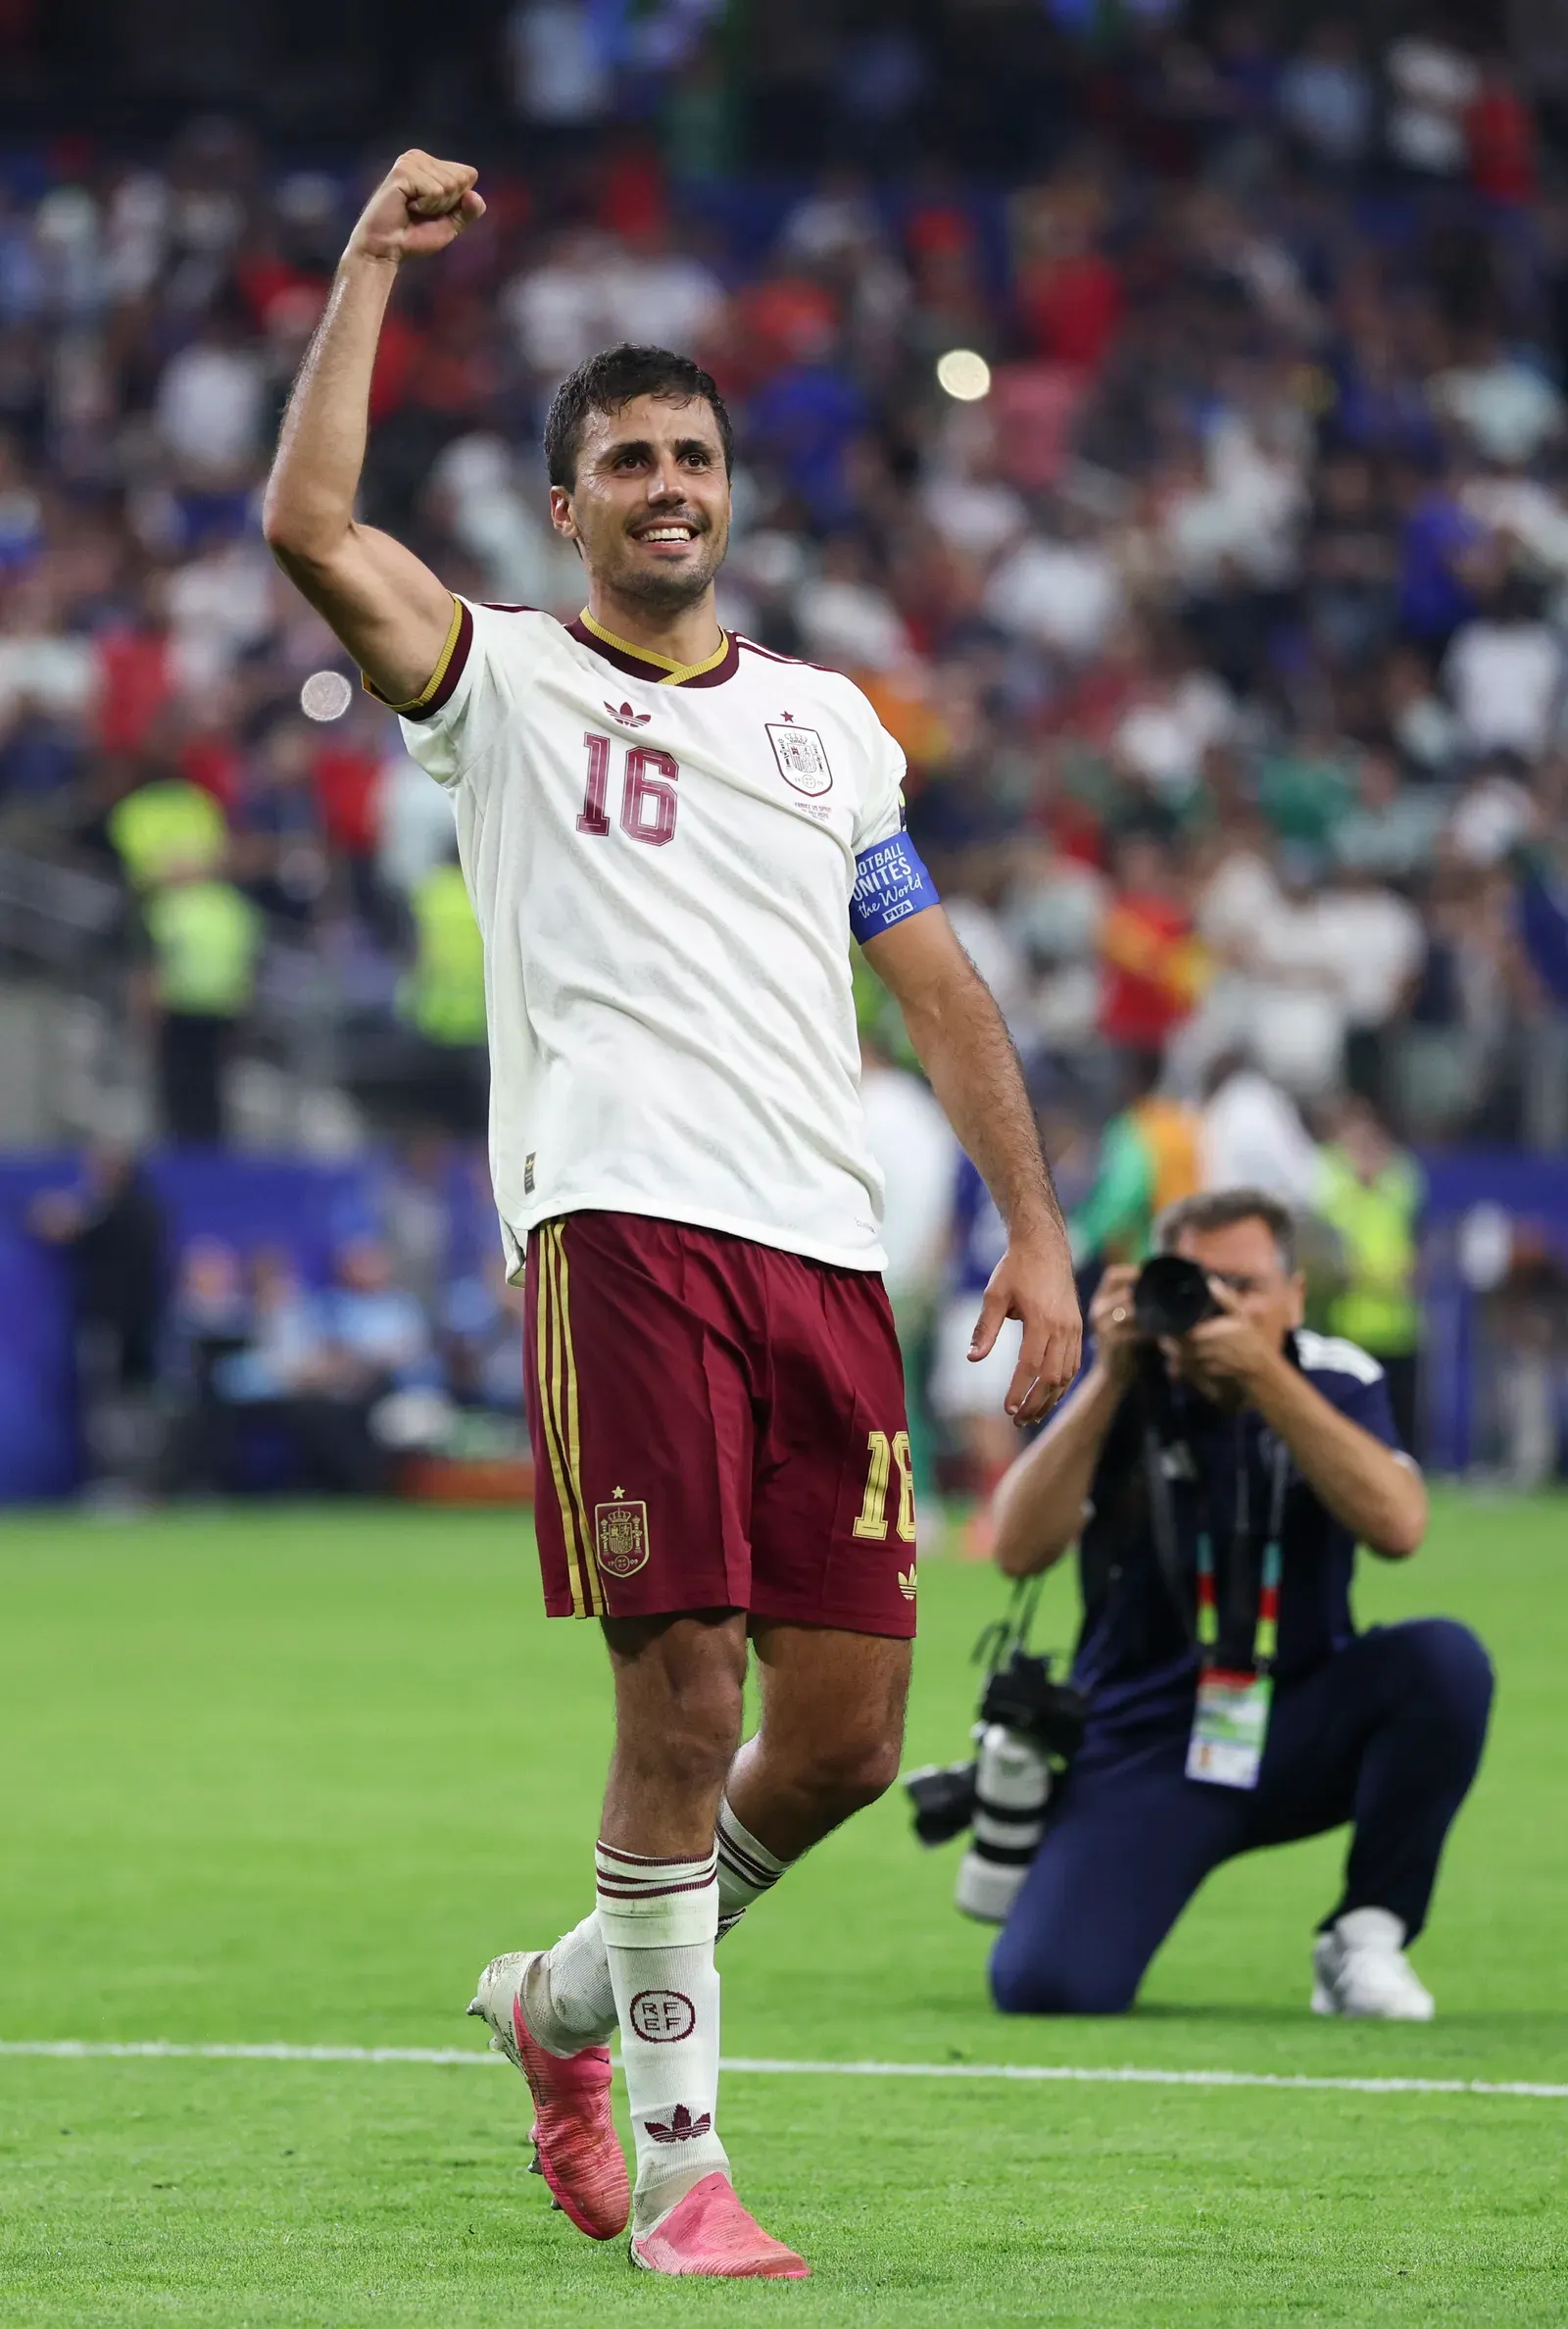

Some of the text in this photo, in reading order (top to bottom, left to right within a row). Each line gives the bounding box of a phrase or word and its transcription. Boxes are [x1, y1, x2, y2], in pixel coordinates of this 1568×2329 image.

[576, 731, 679, 847] 16
[853, 856, 911, 902] UNITES
[858, 872, 923, 919] the World
[884, 903, 912, 922] FIFA
